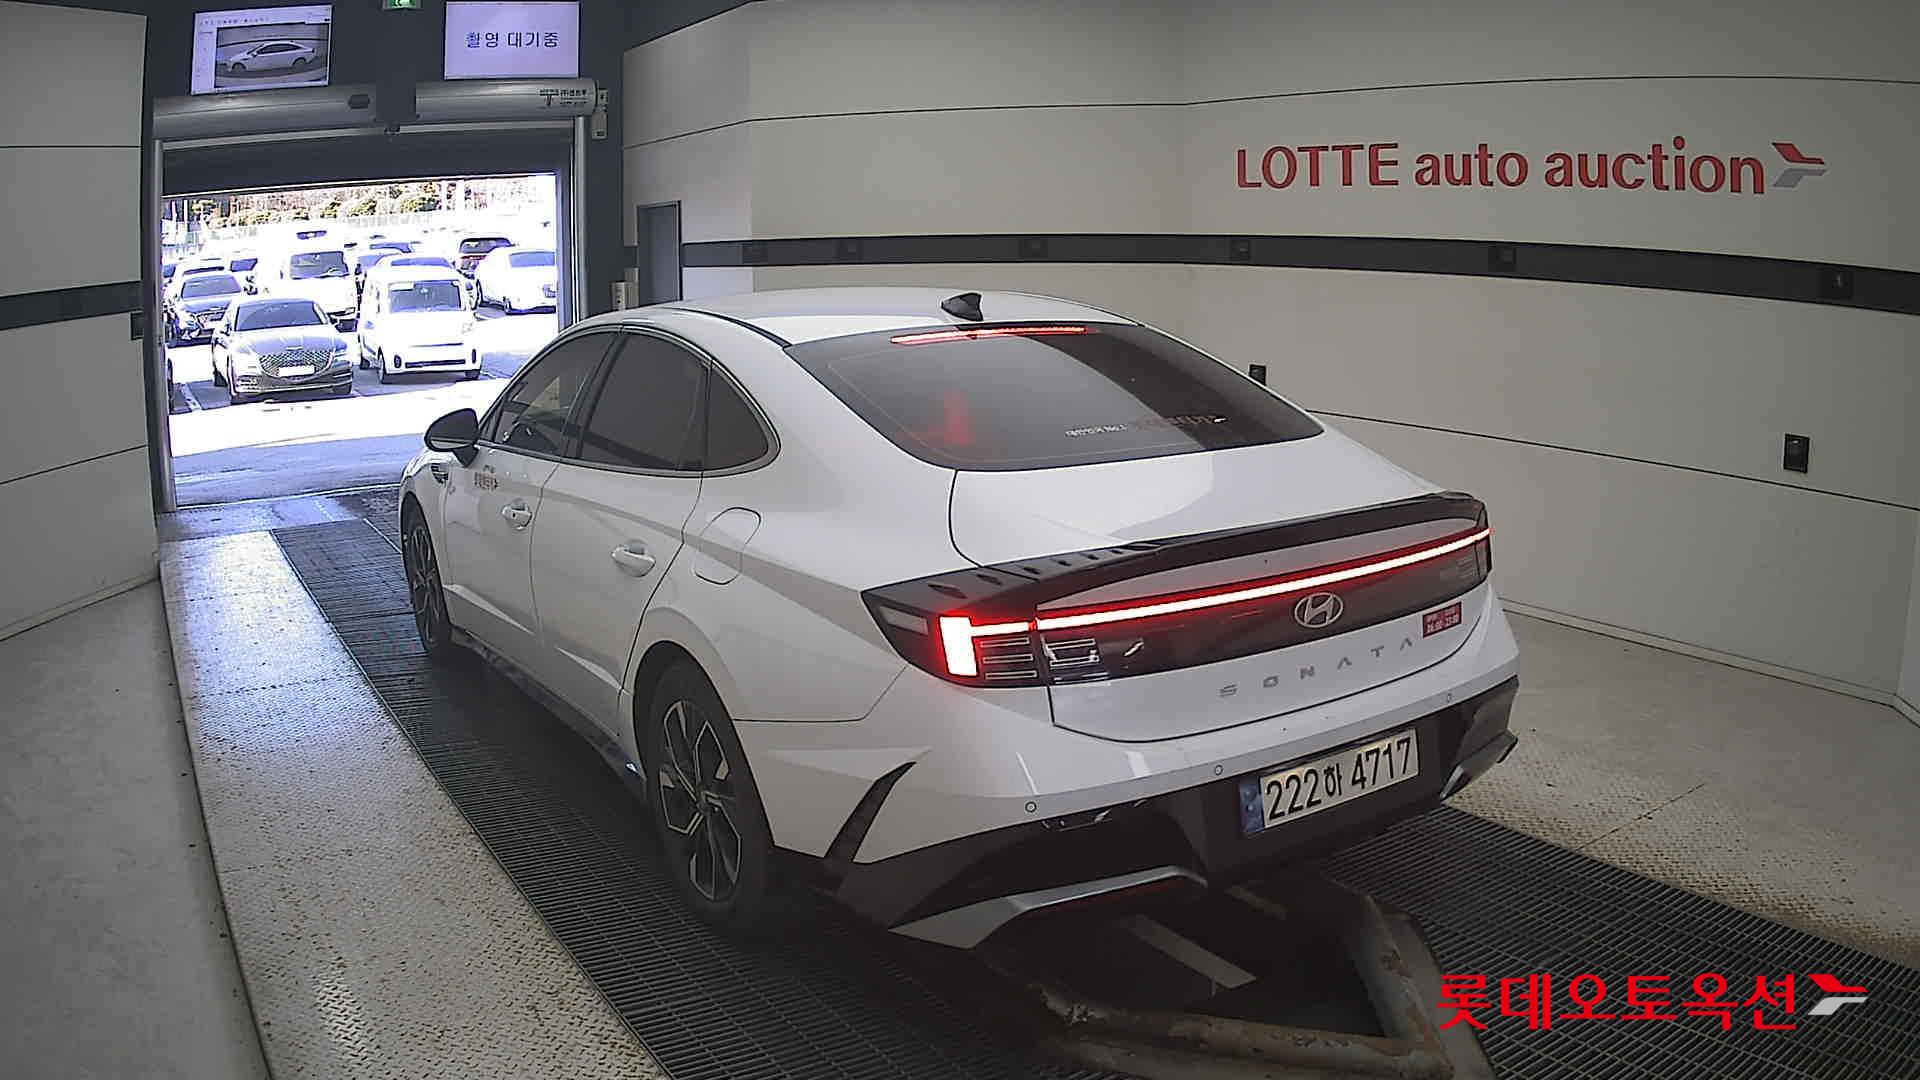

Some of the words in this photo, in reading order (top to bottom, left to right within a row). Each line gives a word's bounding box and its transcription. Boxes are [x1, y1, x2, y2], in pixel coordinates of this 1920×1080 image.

[507, 31, 560, 49] 대기중
[1236, 142, 1400, 190] LOTTE
[1414, 143, 1530, 188] auto
[1543, 136, 1765, 195] auction
[1219, 637, 1413, 698] SONATA
[1266, 763, 1343, 821] 222하
[1351, 736, 1411, 790] 4717
